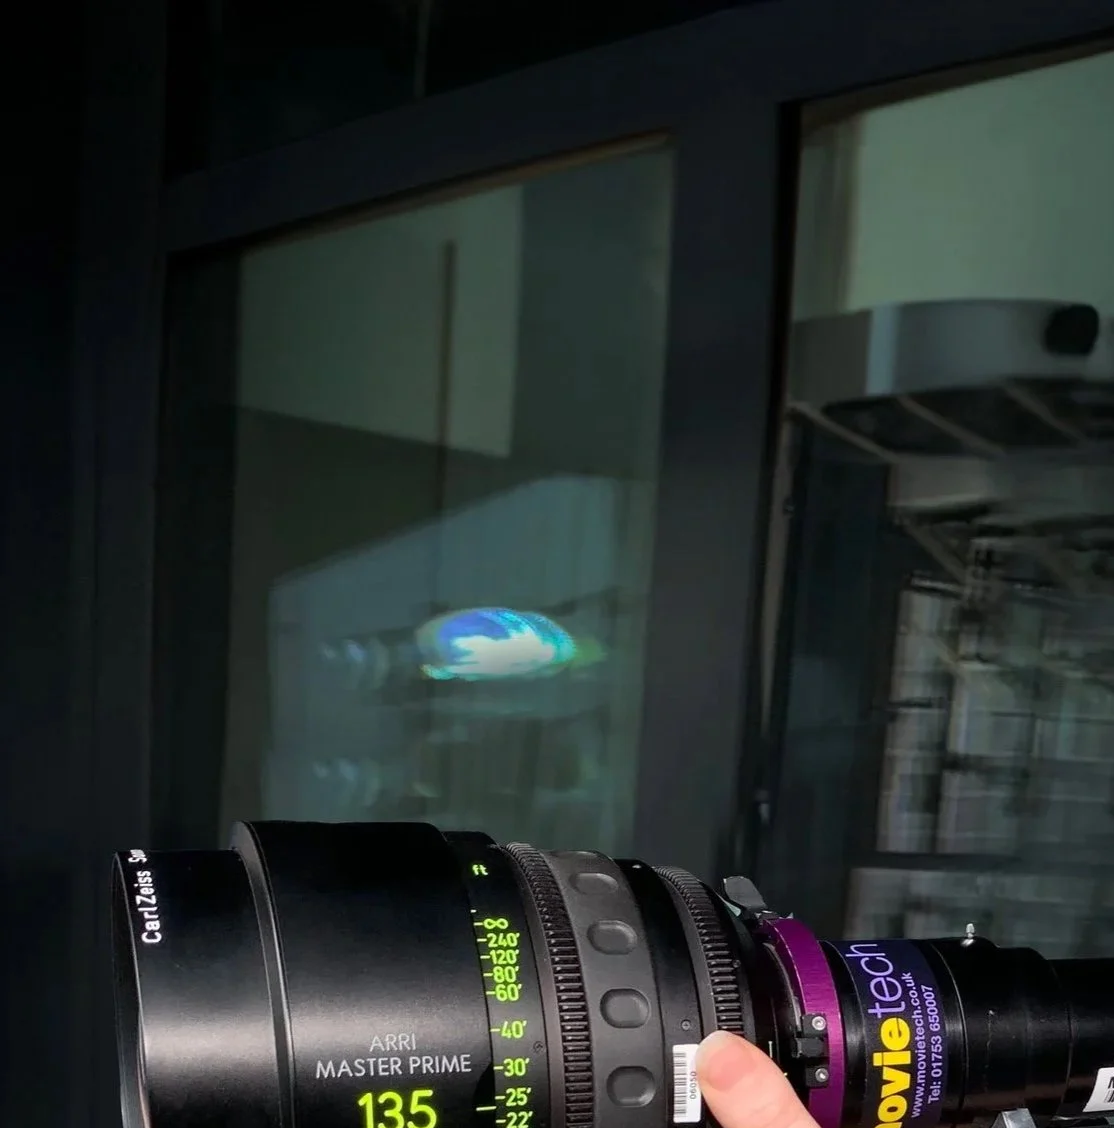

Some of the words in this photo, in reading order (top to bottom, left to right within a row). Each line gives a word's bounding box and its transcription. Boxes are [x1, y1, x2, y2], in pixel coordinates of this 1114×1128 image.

[134, 870, 157, 905] Zeiss
[472, 864, 488, 876] ft
[137, 907, 162, 943] Carl
[921, 985, 940, 1033] 650007
[370, 1033, 416, 1052] ARRI
[902, 972, 927, 1118] www.movietech.co.uk
[931, 1036, 943, 1078] 01753
[316, 1057, 402, 1079] MASTER
[409, 1054, 472, 1074] PRIME
[927, 1080, 942, 1104] Tel:
